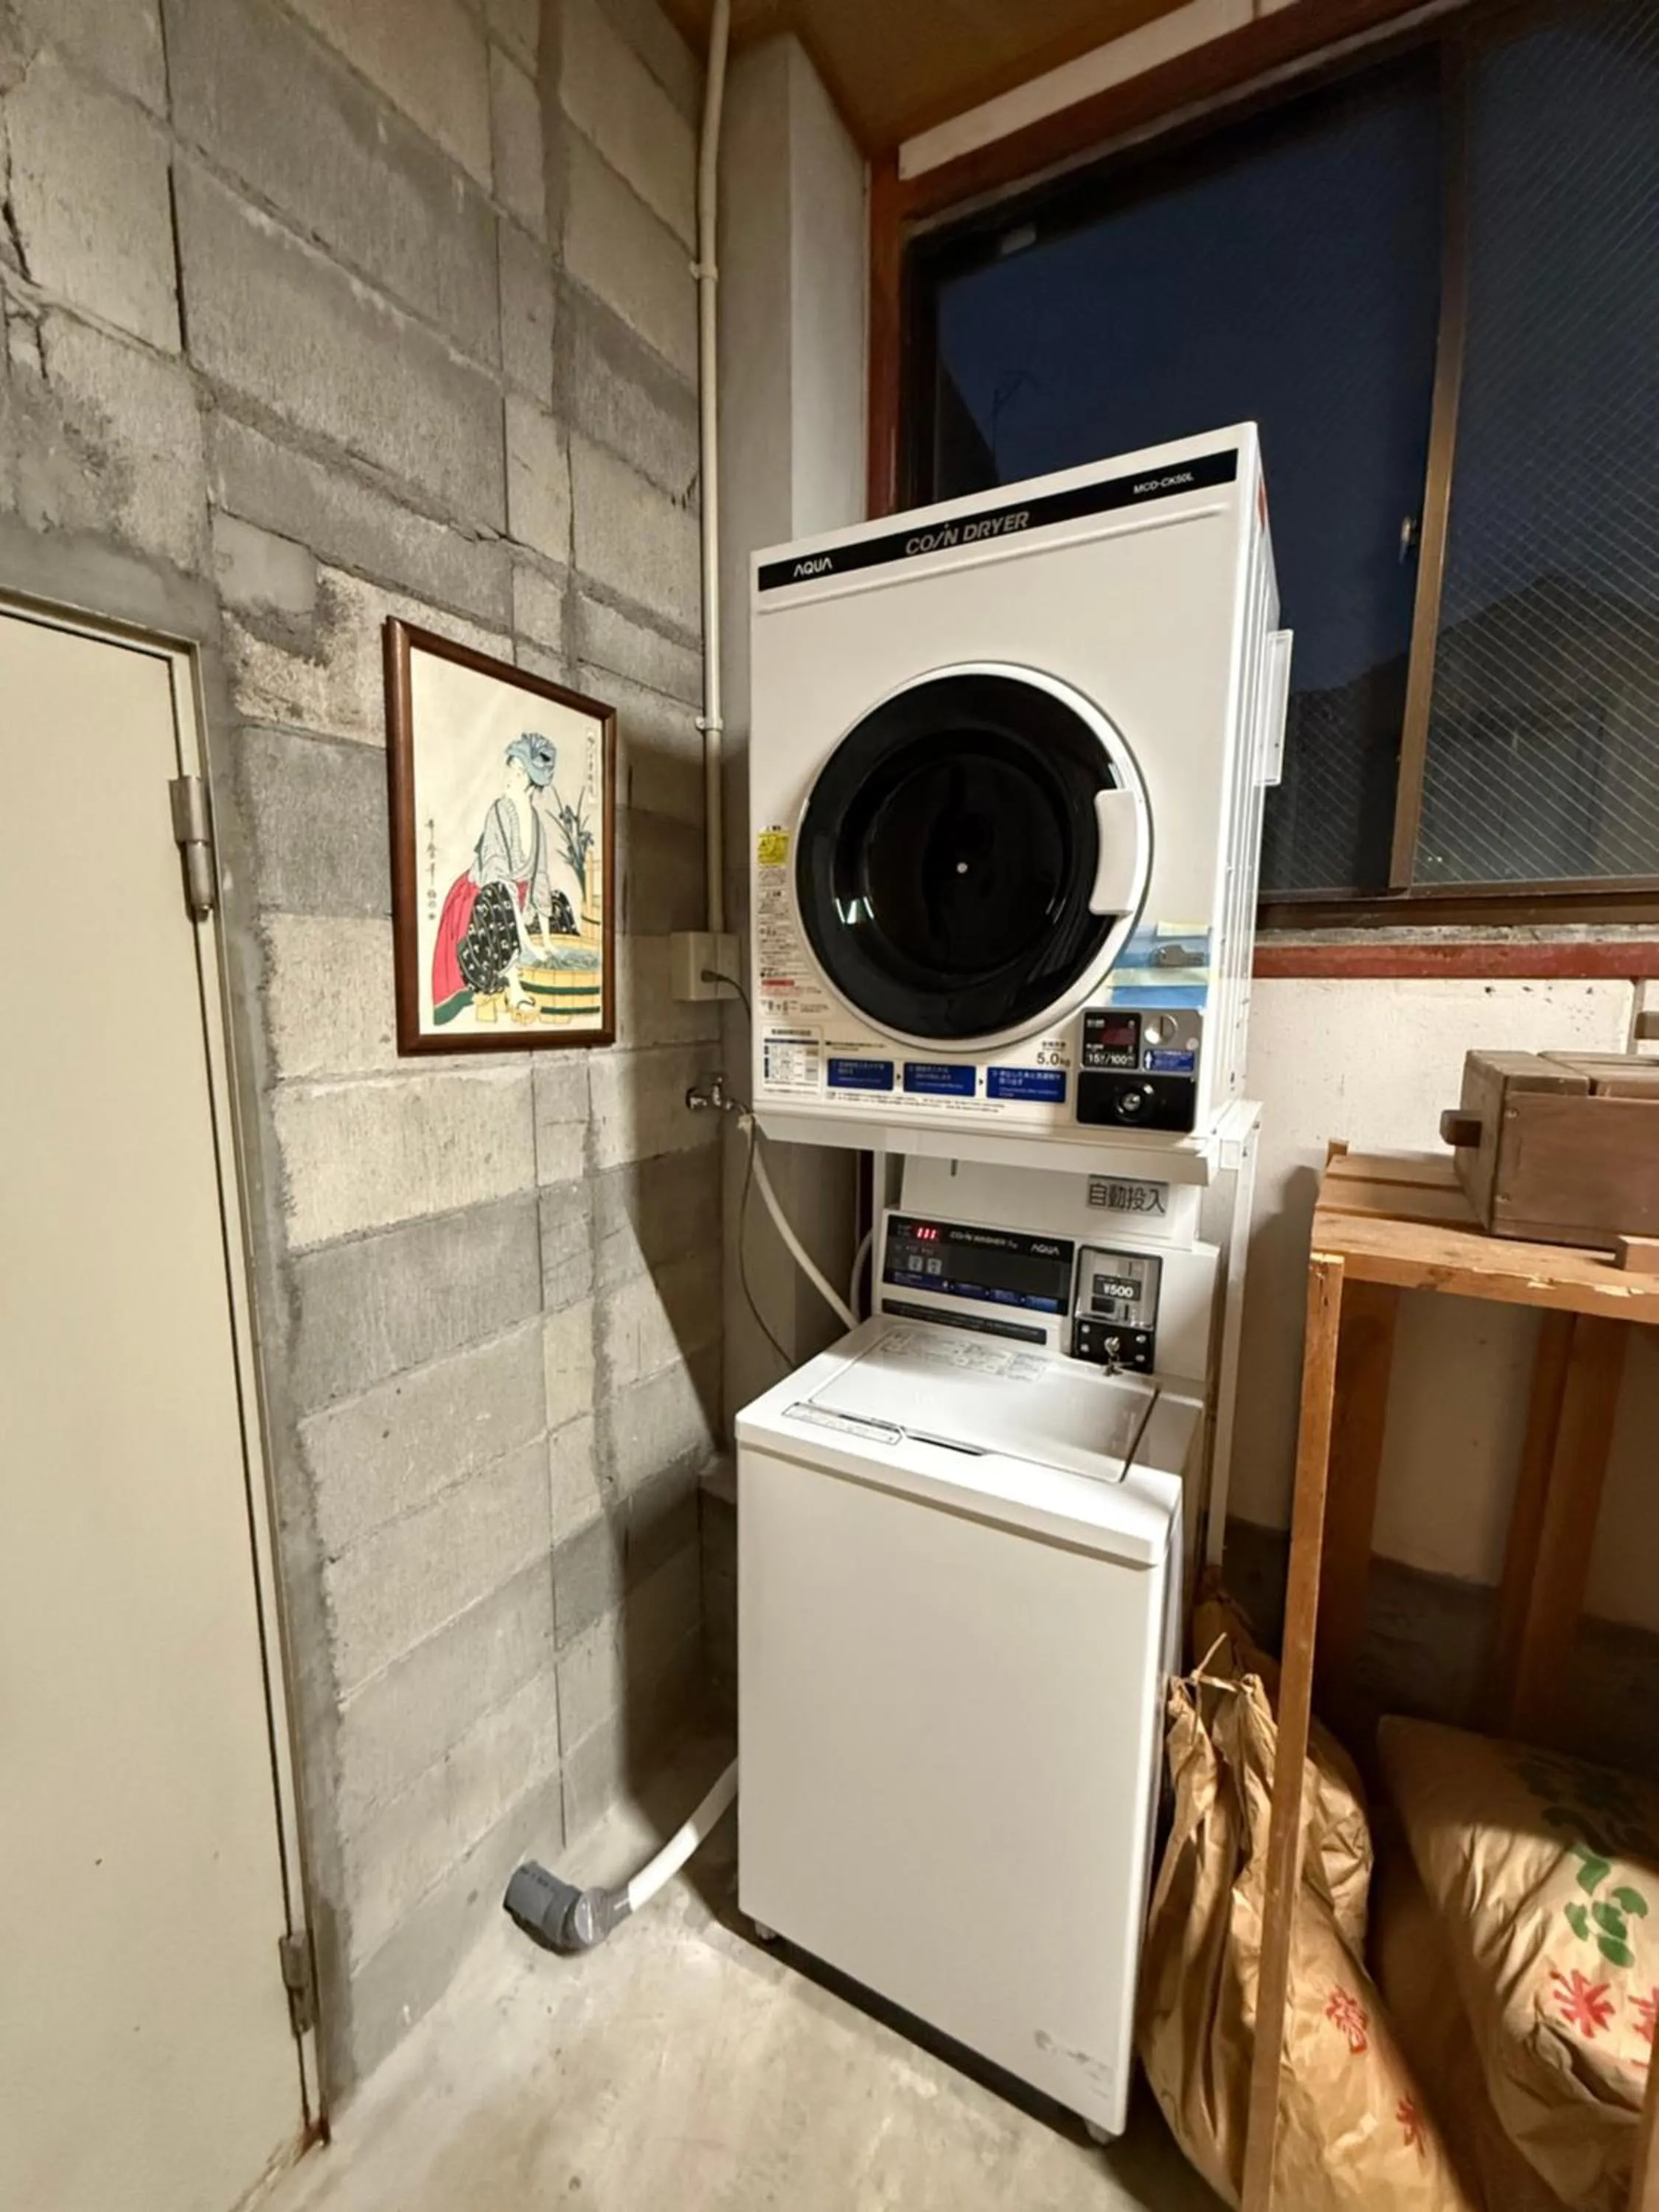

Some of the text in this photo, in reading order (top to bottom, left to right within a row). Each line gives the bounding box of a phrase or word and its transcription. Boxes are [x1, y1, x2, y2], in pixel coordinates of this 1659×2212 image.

[1133, 472, 1194, 494] MCD-CK50L
[905, 512, 1029, 554] COIN DRYER
[793, 557, 832, 577] AQUA
[1089, 1183, 1165, 1213] 自動投入
[1103, 1283, 1134, 1298] ¥500
